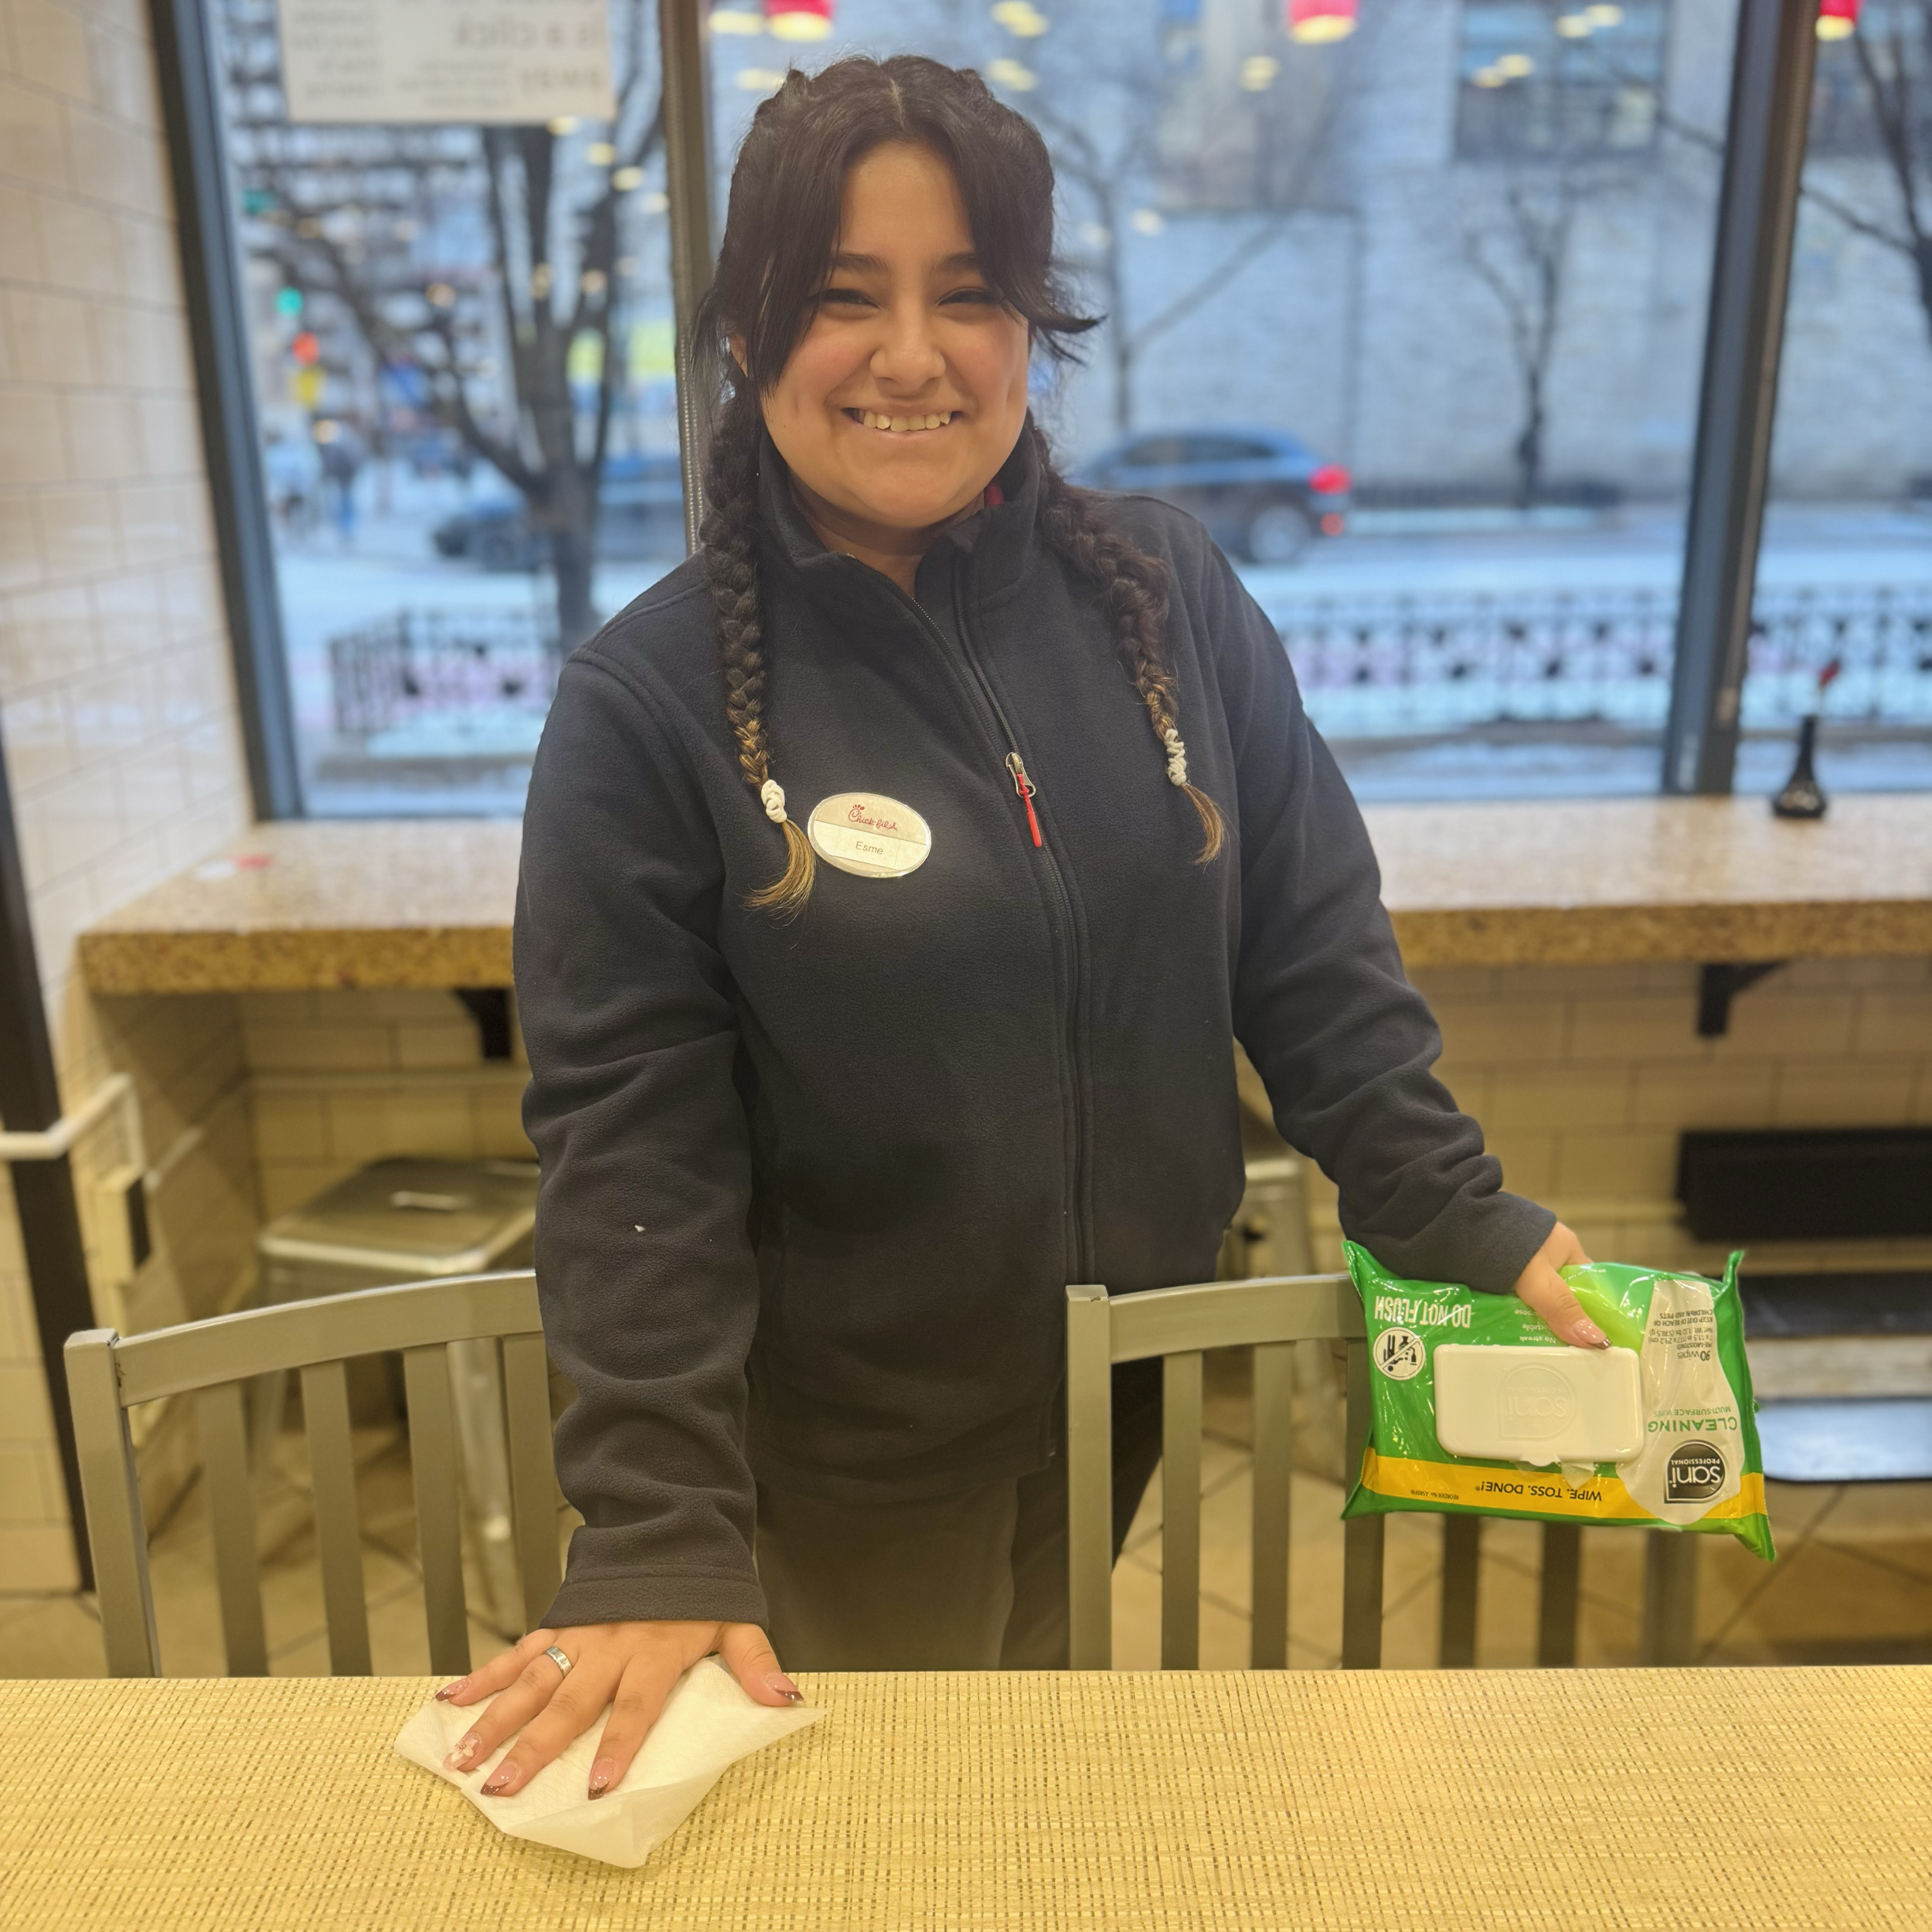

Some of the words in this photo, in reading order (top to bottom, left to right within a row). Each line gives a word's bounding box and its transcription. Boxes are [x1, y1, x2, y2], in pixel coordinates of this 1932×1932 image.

[855, 842, 884, 855] Esme
[1374, 1296, 1418, 1324] FLUSH
[1420, 1301, 1448, 1326] NOT
[1451, 1304, 1471, 1328] DO
[1677, 1349, 1700, 1359] wipes
[1700, 1350, 1711, 1362] 90
[1509, 1396, 1567, 1420] sani
[1674, 1406, 1731, 1416] MULTI-SURFACE
[1647, 1417, 1737, 1433] CLEANING
[1672, 1465, 1721, 1488] sani
[1528, 1485, 1563, 1498] TOSS.
[1566, 1488, 1602, 1502] WIPE.
